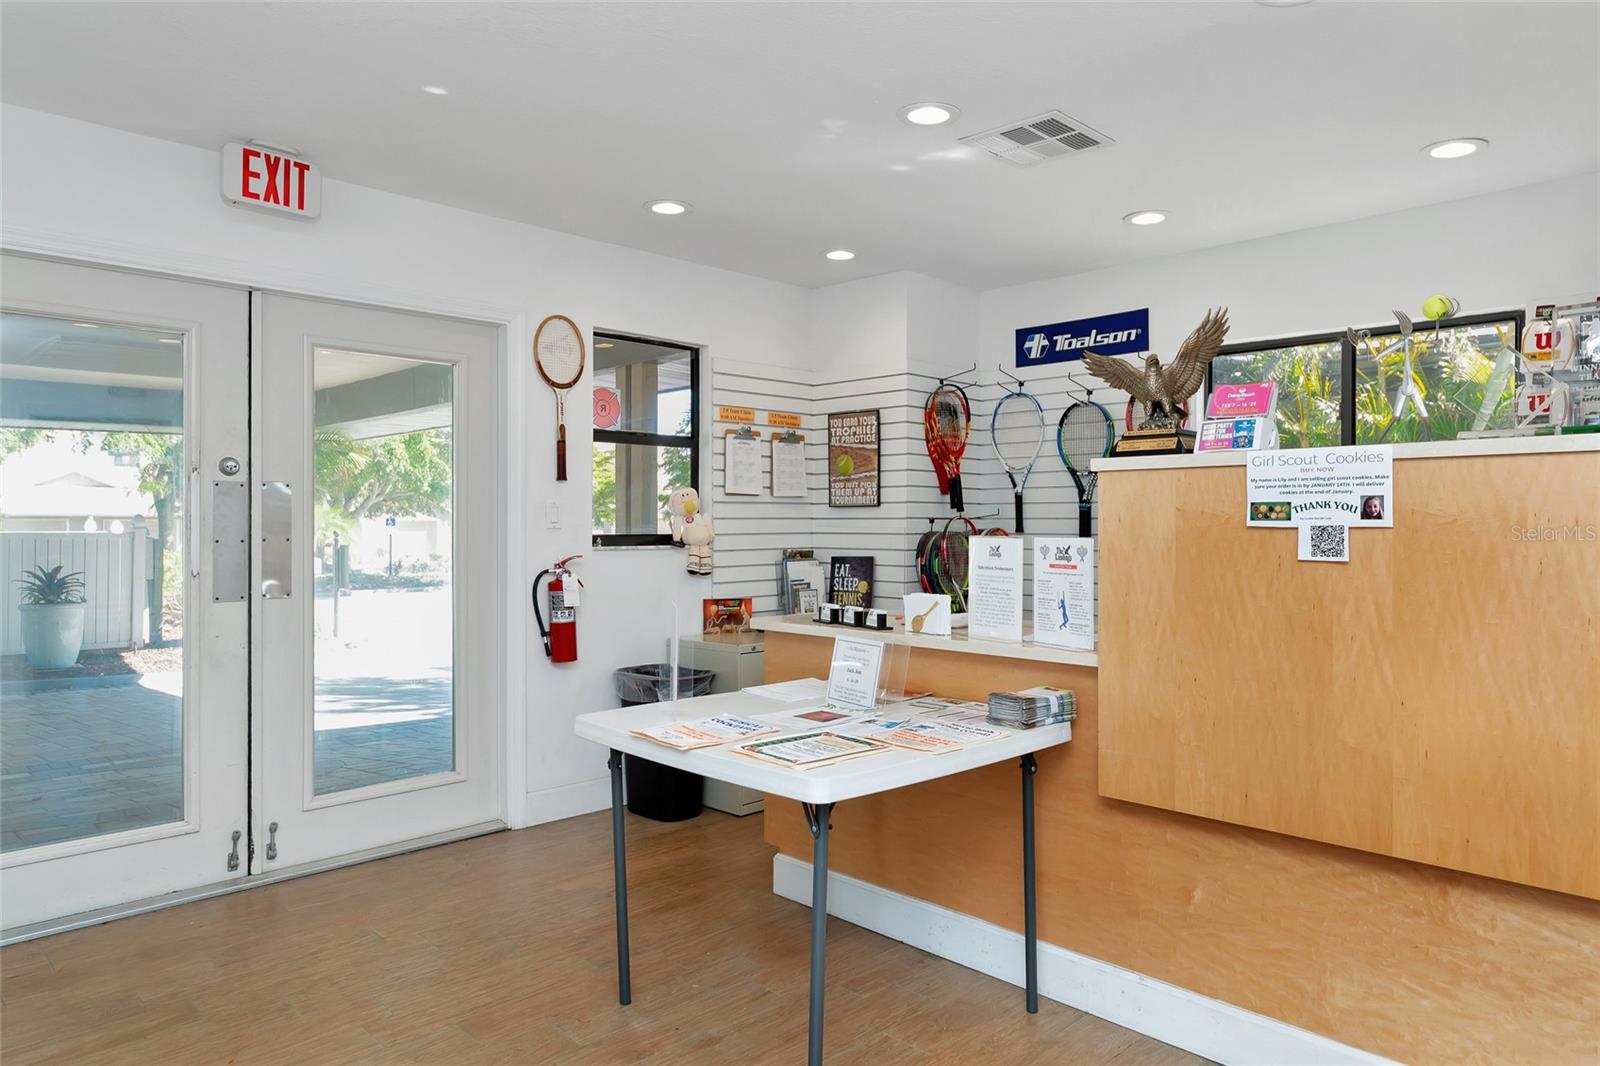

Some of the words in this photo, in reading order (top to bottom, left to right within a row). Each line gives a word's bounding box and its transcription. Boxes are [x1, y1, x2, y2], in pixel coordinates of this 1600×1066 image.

[242, 148, 310, 210] EXIT
[1053, 329, 1137, 352] Toalson
[830, 418, 842, 428] YOU
[843, 416, 858, 427] EARN
[859, 415, 877, 425] YOUR
[831, 425, 876, 436] TROPHIES
[831, 436, 840, 445] AT
[841, 434, 876, 444] PRACTICE
[1252, 456, 1274, 468] Girl
[1278, 454, 1319, 467] Scout
[1325, 451, 1385, 465] Cookies
[831, 488, 852, 496] THEM
[854, 488, 865, 496] UP
[866, 487, 878, 496] AT
[831, 495, 878, 505] TOURNAMENTS
[1292, 501, 1332, 514] THANK
[1333, 501, 1359, 514] YOU
[834, 563, 851, 577] EAT.
[833, 577, 859, 591] SLEEP.
[833, 591, 865, 606] TENNIS.
